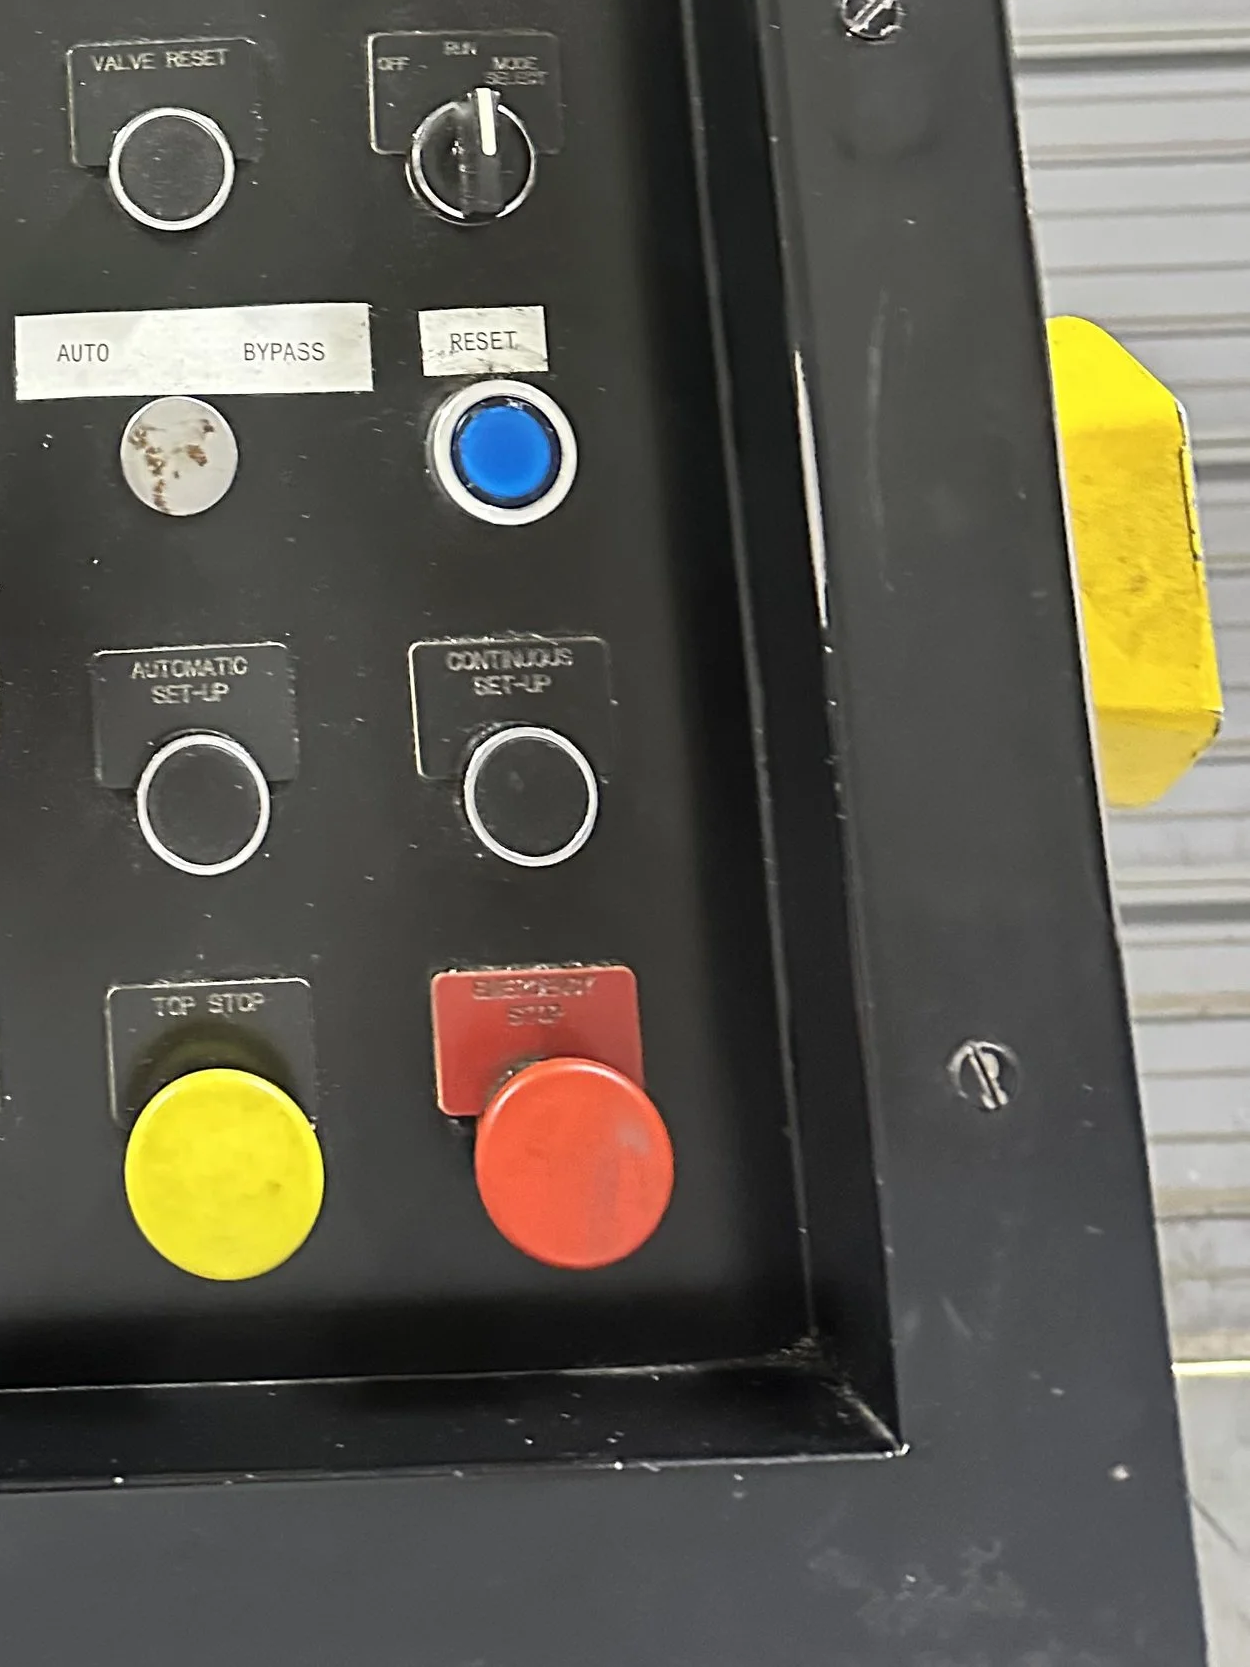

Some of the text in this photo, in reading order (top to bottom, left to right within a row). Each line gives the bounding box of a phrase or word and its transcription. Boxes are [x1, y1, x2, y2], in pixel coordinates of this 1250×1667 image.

[92, 48, 230, 73] VALVE RESET
[376, 56, 411, 71] OFF
[491, 55, 539, 70] MODE
[243, 341, 326, 363] BYPASS
[450, 330, 518, 353] RESET
[56, 343, 110, 363] AUTO
[130, 654, 249, 680] AUTOMATIC
[445, 647, 574, 672] CONTINUOUS
[150, 683, 230, 705] SET-UP
[472, 675, 552, 697] SET-UP
[152, 991, 265, 1017] TOP STOP
